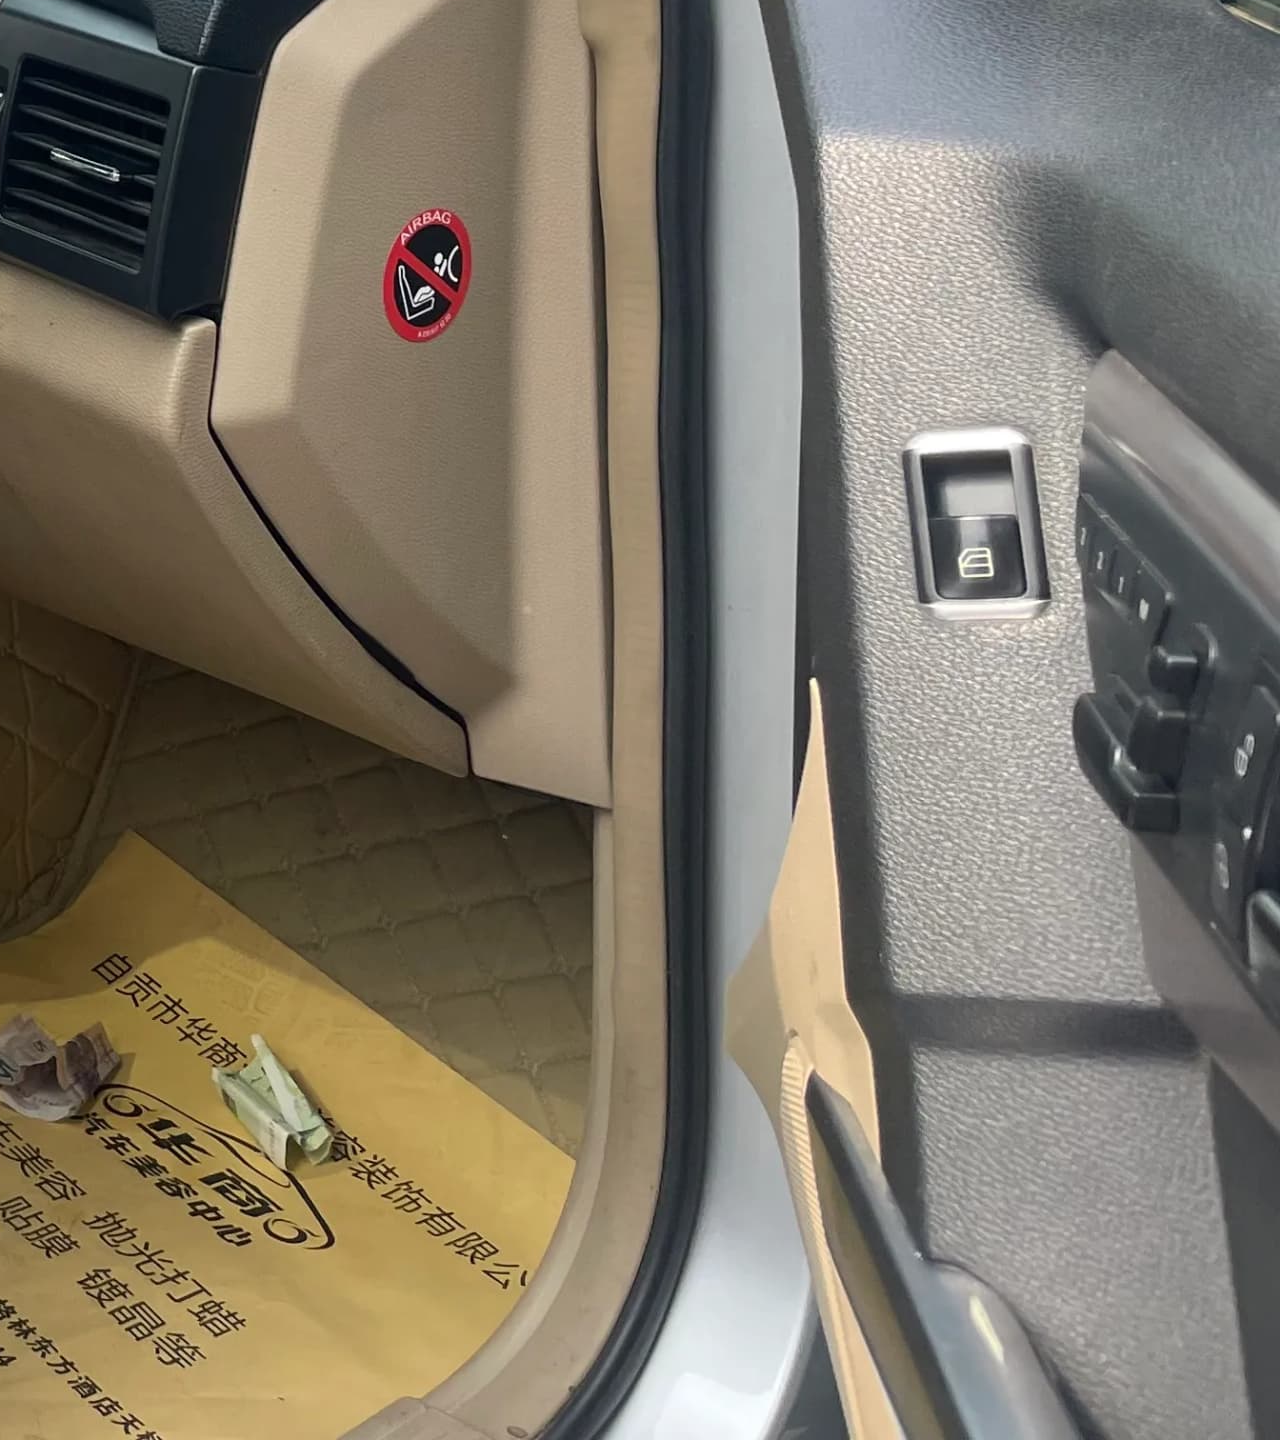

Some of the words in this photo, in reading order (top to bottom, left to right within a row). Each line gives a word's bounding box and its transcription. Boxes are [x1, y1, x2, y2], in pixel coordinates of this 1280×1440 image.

[400, 210, 453, 245] AIRBAG
[76, 1267, 208, 1369] 镀晶等
[82, 1210, 247, 1338] 抛光打蜡
